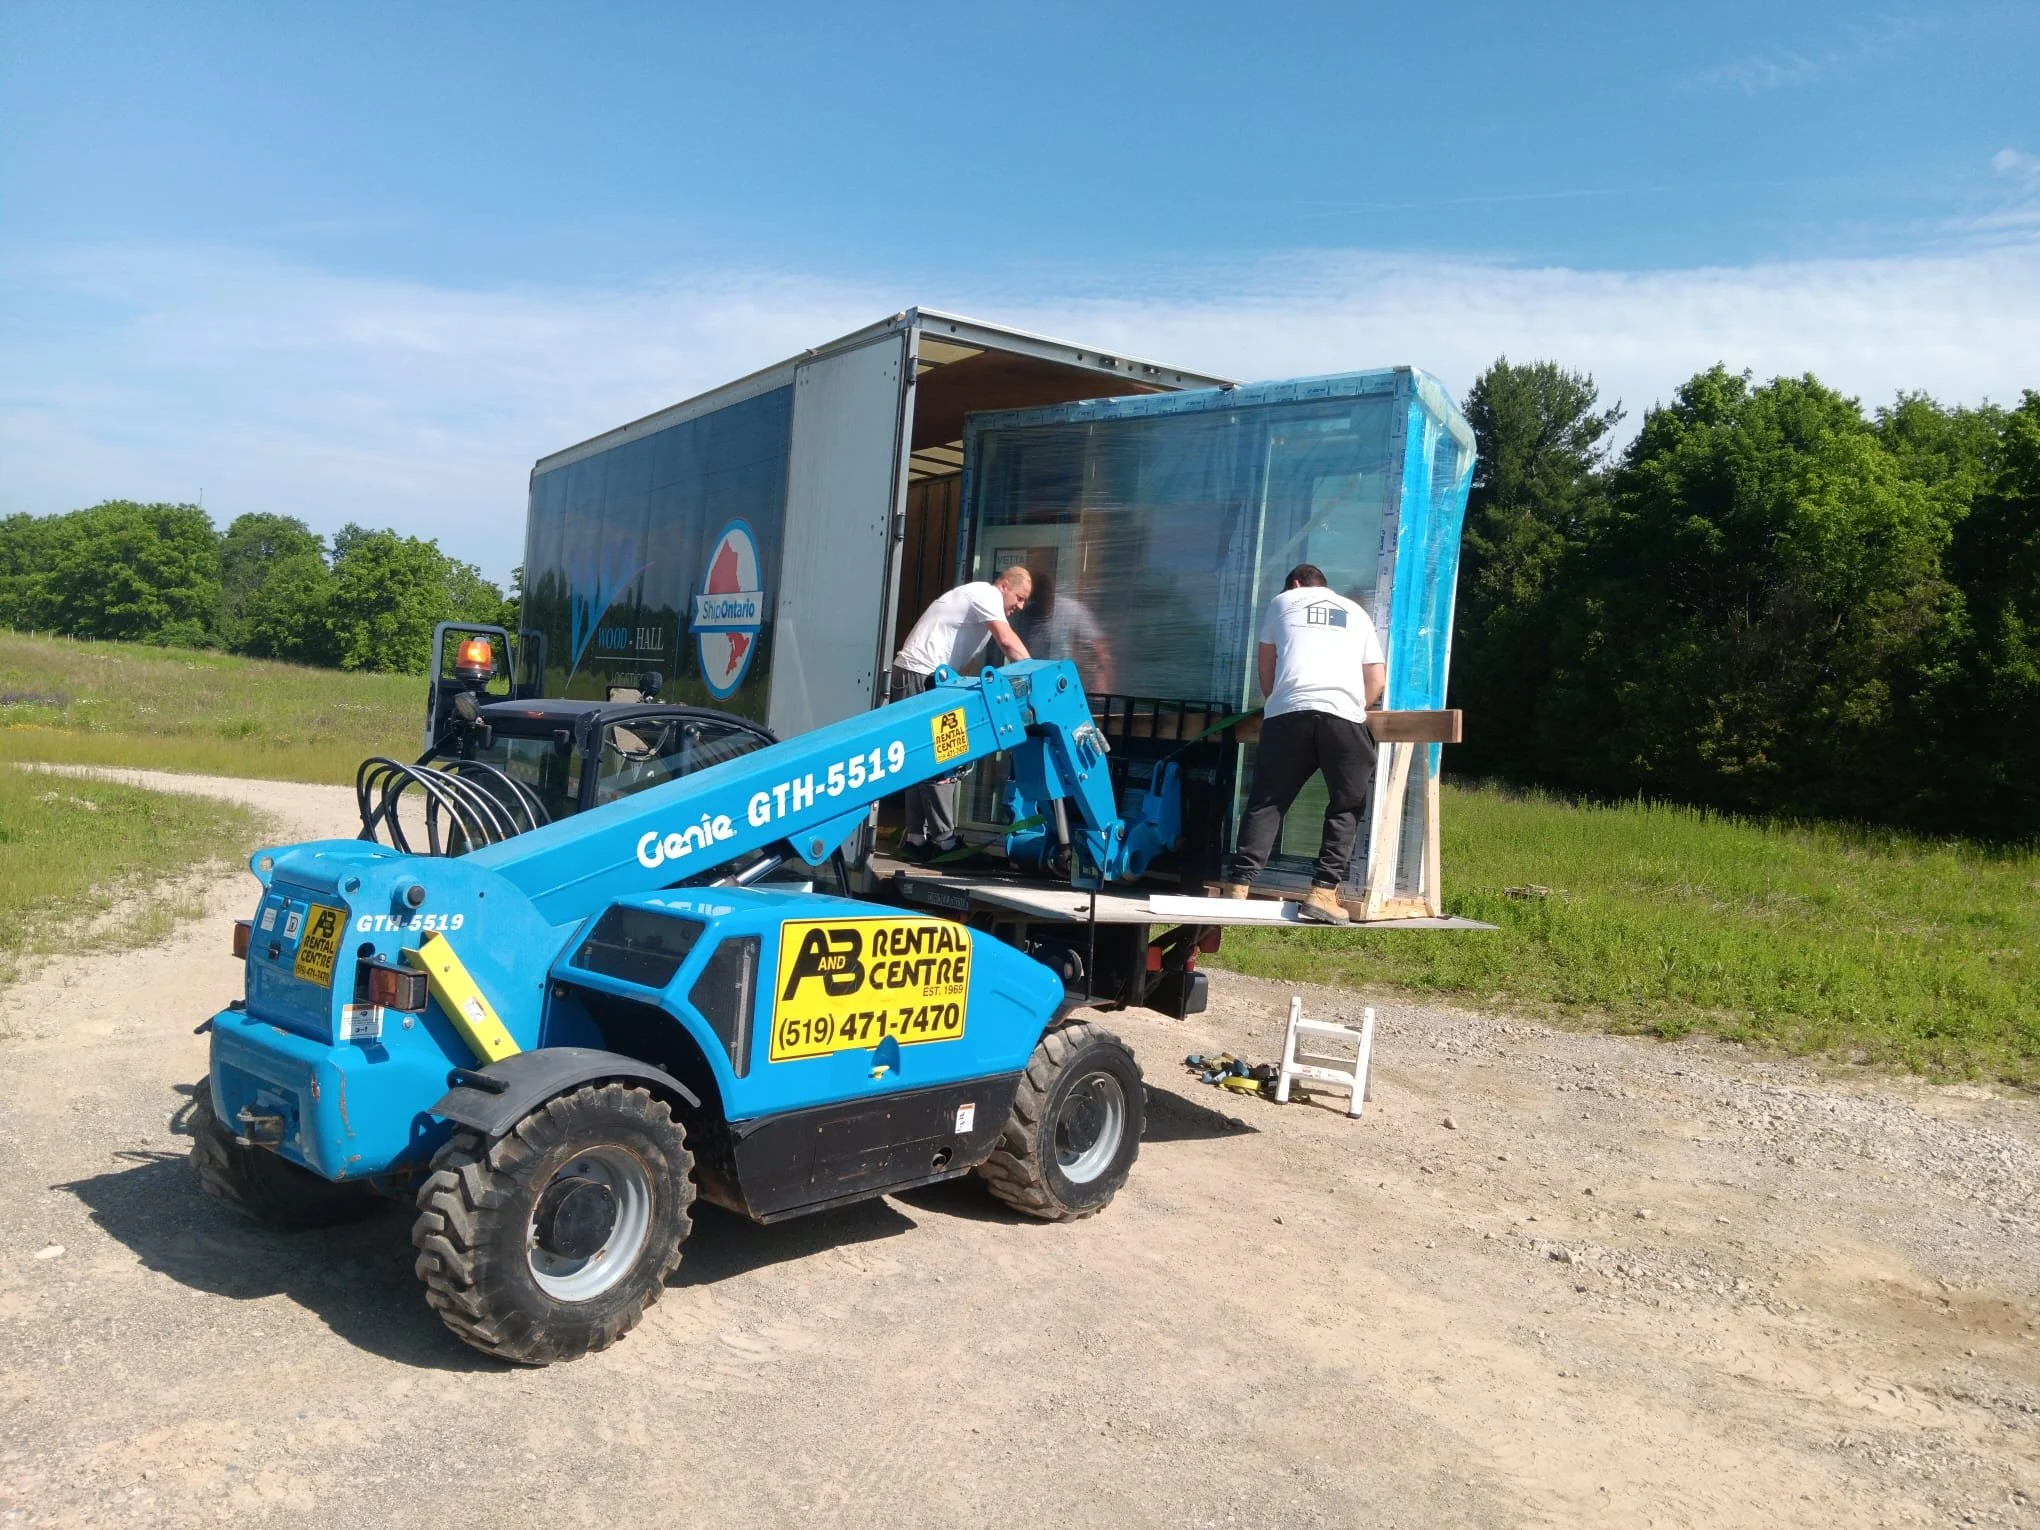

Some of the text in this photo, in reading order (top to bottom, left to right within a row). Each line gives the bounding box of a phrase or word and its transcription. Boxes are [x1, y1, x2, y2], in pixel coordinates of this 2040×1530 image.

[702, 598, 756, 622] ShipOntario
[598, 627, 629, 650] WOOD
[634, 627, 664, 651] HALL
[936, 726, 965, 745] RENTAL
[936, 735, 966, 753] CENTRE
[636, 740, 905, 869] Genie GTH-5519
[356, 913, 464, 932] GTH-5519
[304, 935, 334, 954] RENTAL
[871, 926, 967, 958] RENTAL
[300, 949, 333, 969] CENTRE
[817, 955, 846, 972] AND
[869, 956, 966, 990] CENTRE
[922, 985, 964, 997] EST. 1969
[778, 1003, 960, 1051] (519) 471-7470
